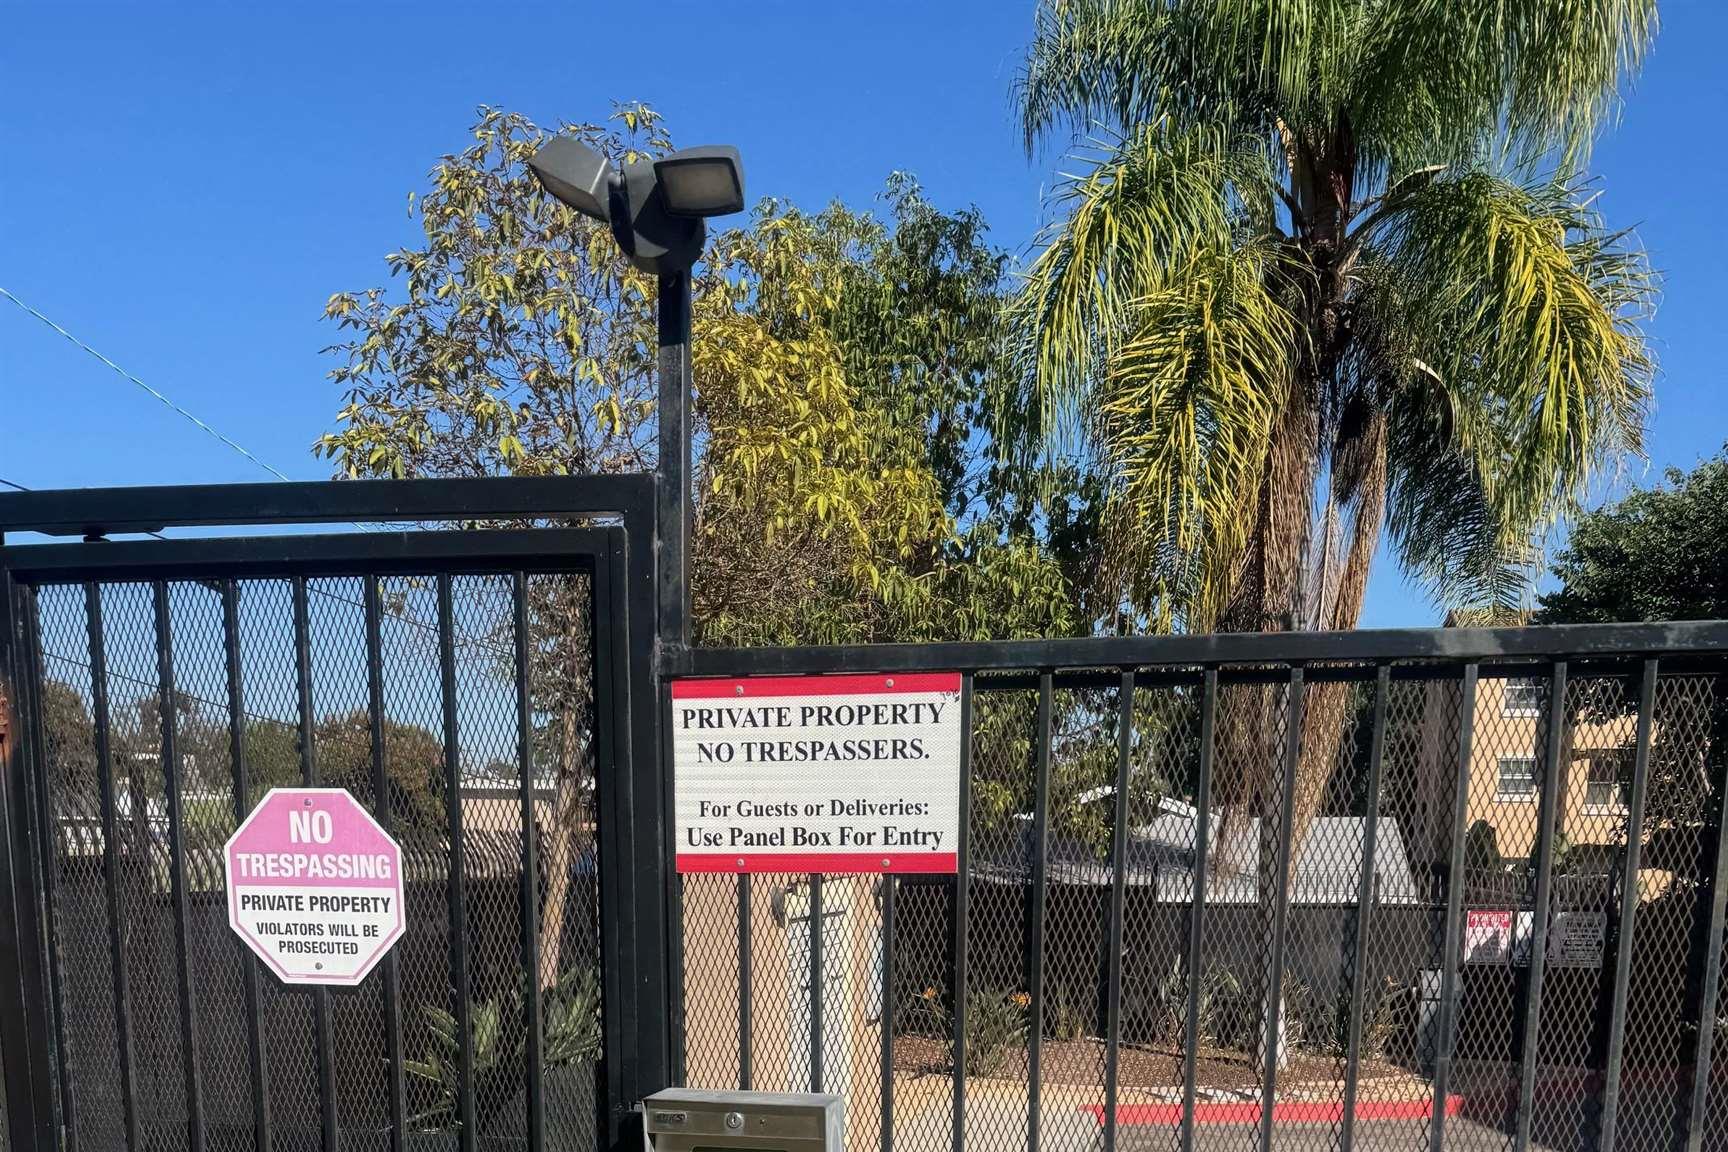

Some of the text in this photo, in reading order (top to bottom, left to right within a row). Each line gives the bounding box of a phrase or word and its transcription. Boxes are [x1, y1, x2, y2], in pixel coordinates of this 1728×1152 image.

[681, 702, 946, 730] PRIVATE PROPERTY
[696, 738, 931, 764] NO TRESPASSERS.
[699, 798, 929, 818] For Guests or Deliveries:
[289, 809, 334, 844] NO
[686, 826, 944, 852] Use Panel Box For Entry
[236, 853, 392, 879] TRESPASSING
[241, 894, 391, 914] PRIVATE PROPERTY
[256, 922, 380, 937] VIOLATORS WILL BE
[279, 940, 359, 955] PROSECUTED
